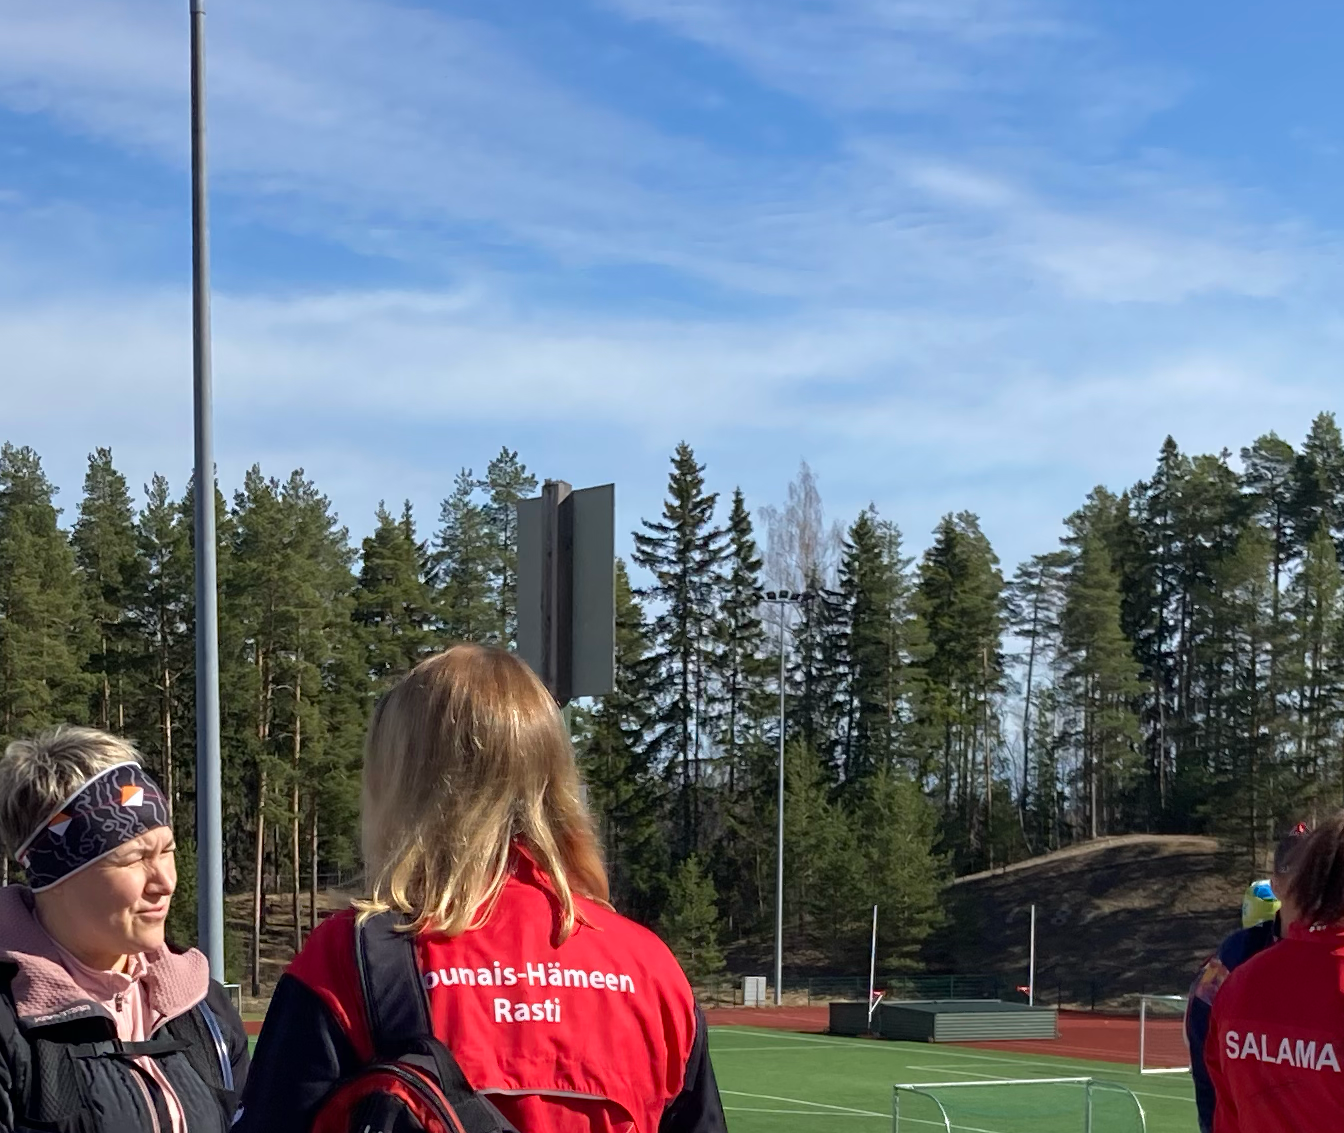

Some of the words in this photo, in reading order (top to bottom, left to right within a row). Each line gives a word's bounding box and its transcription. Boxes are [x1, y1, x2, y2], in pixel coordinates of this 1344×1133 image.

[423, 960, 635, 993] ounais-Hämeen
[493, 997, 561, 1023] Rasti
[1225, 1030, 1342, 1073] SALAMA
